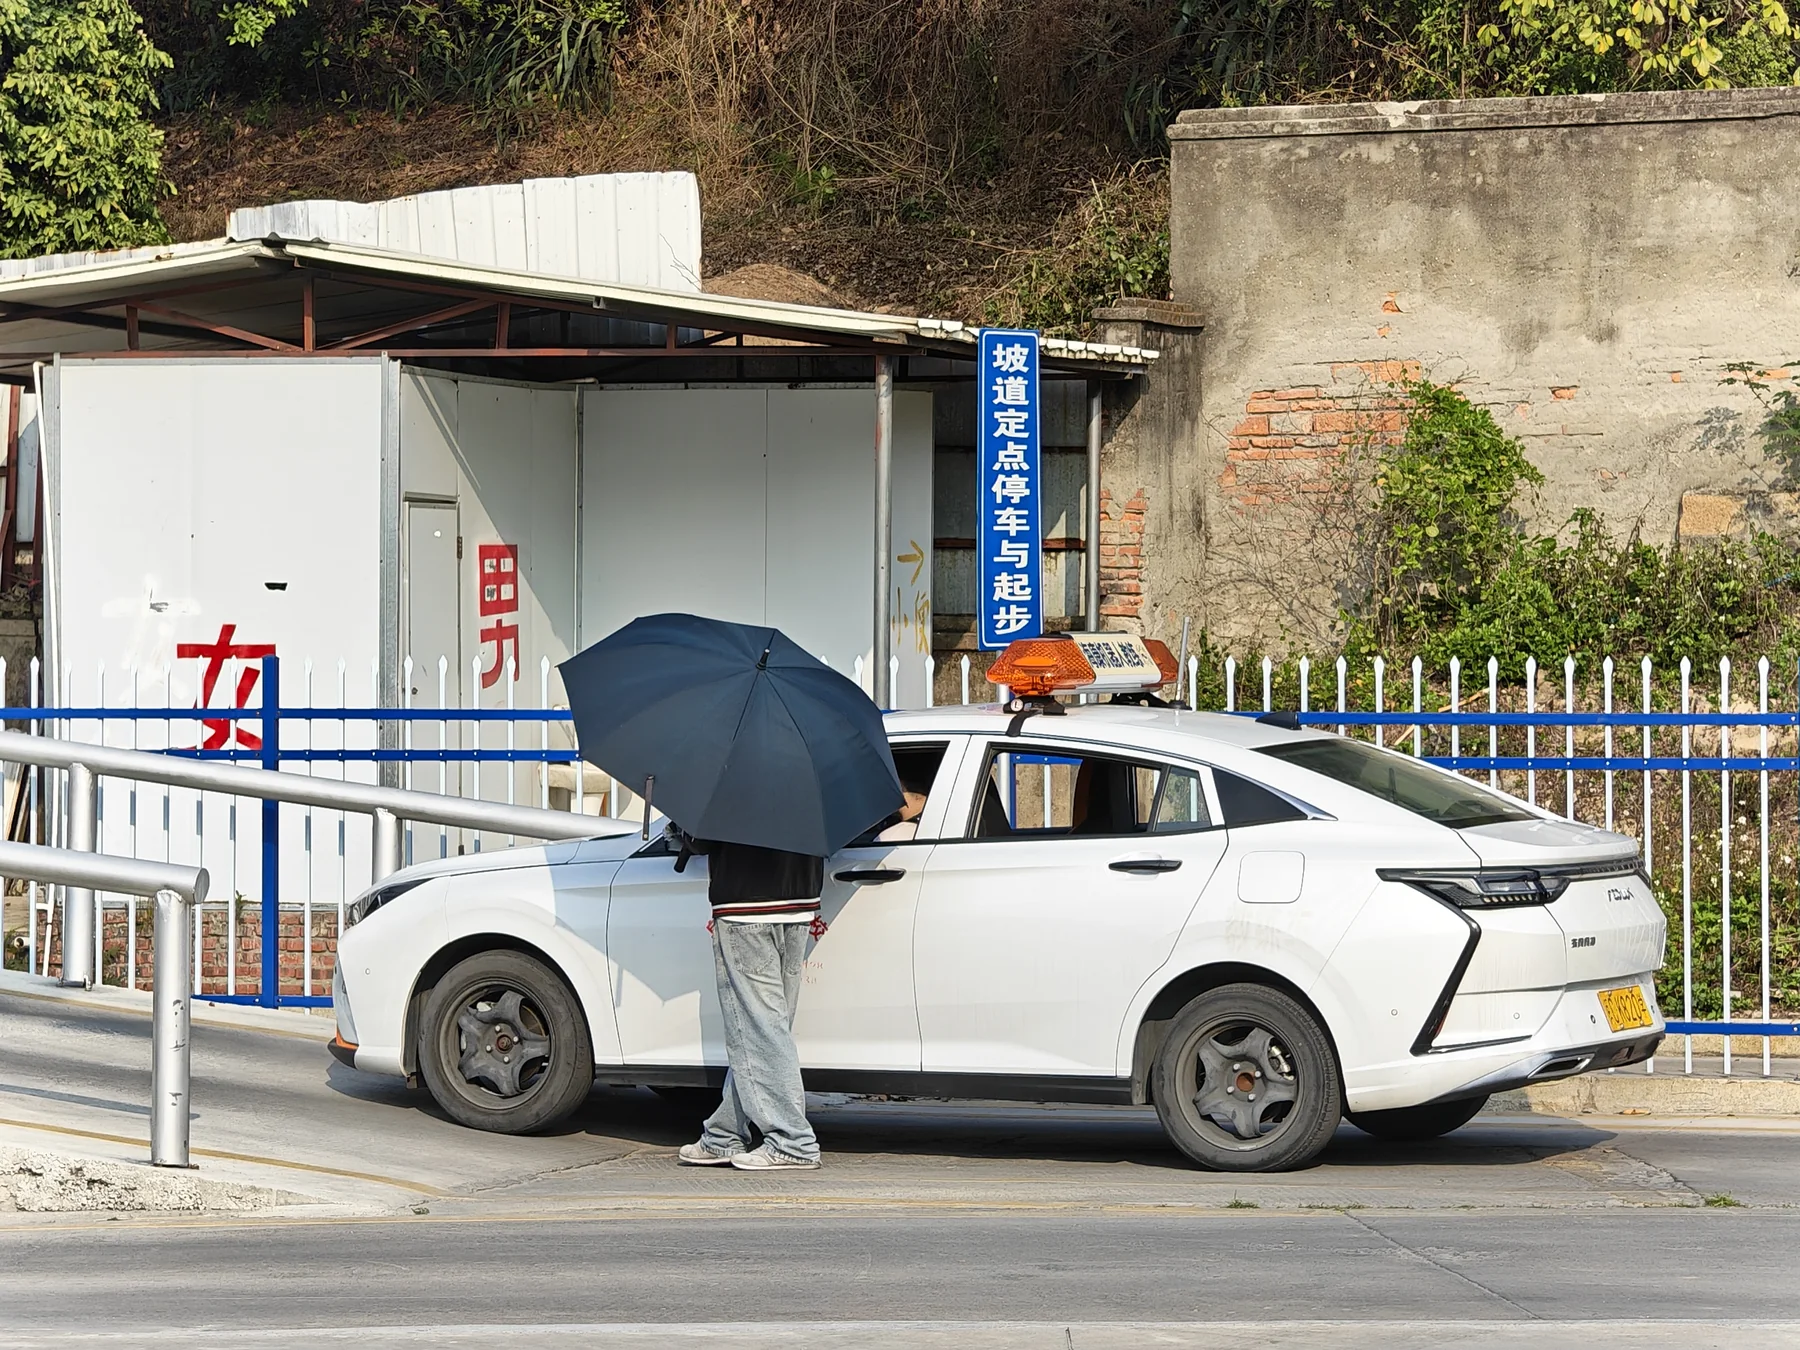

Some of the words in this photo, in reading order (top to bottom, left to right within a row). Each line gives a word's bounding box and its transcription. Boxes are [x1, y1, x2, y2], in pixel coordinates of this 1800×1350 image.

[992, 342, 1033, 635] 坡道定点停车与起步
